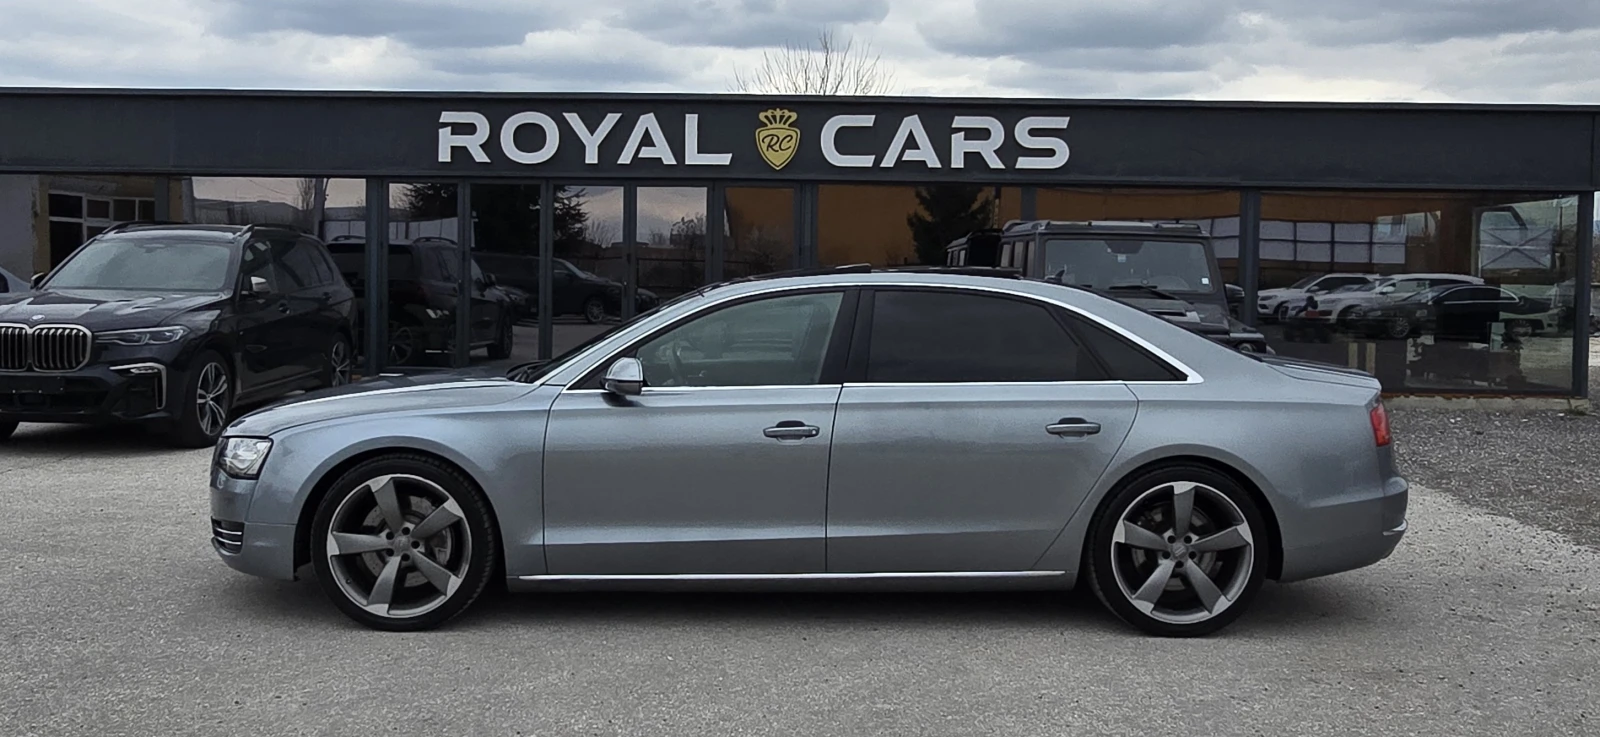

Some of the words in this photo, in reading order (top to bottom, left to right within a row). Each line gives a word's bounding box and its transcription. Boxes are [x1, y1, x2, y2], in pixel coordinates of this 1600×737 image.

[437, 111, 733, 166] ROYAL
[820, 114, 1071, 169] CARS
[761, 133, 794, 153] RC
